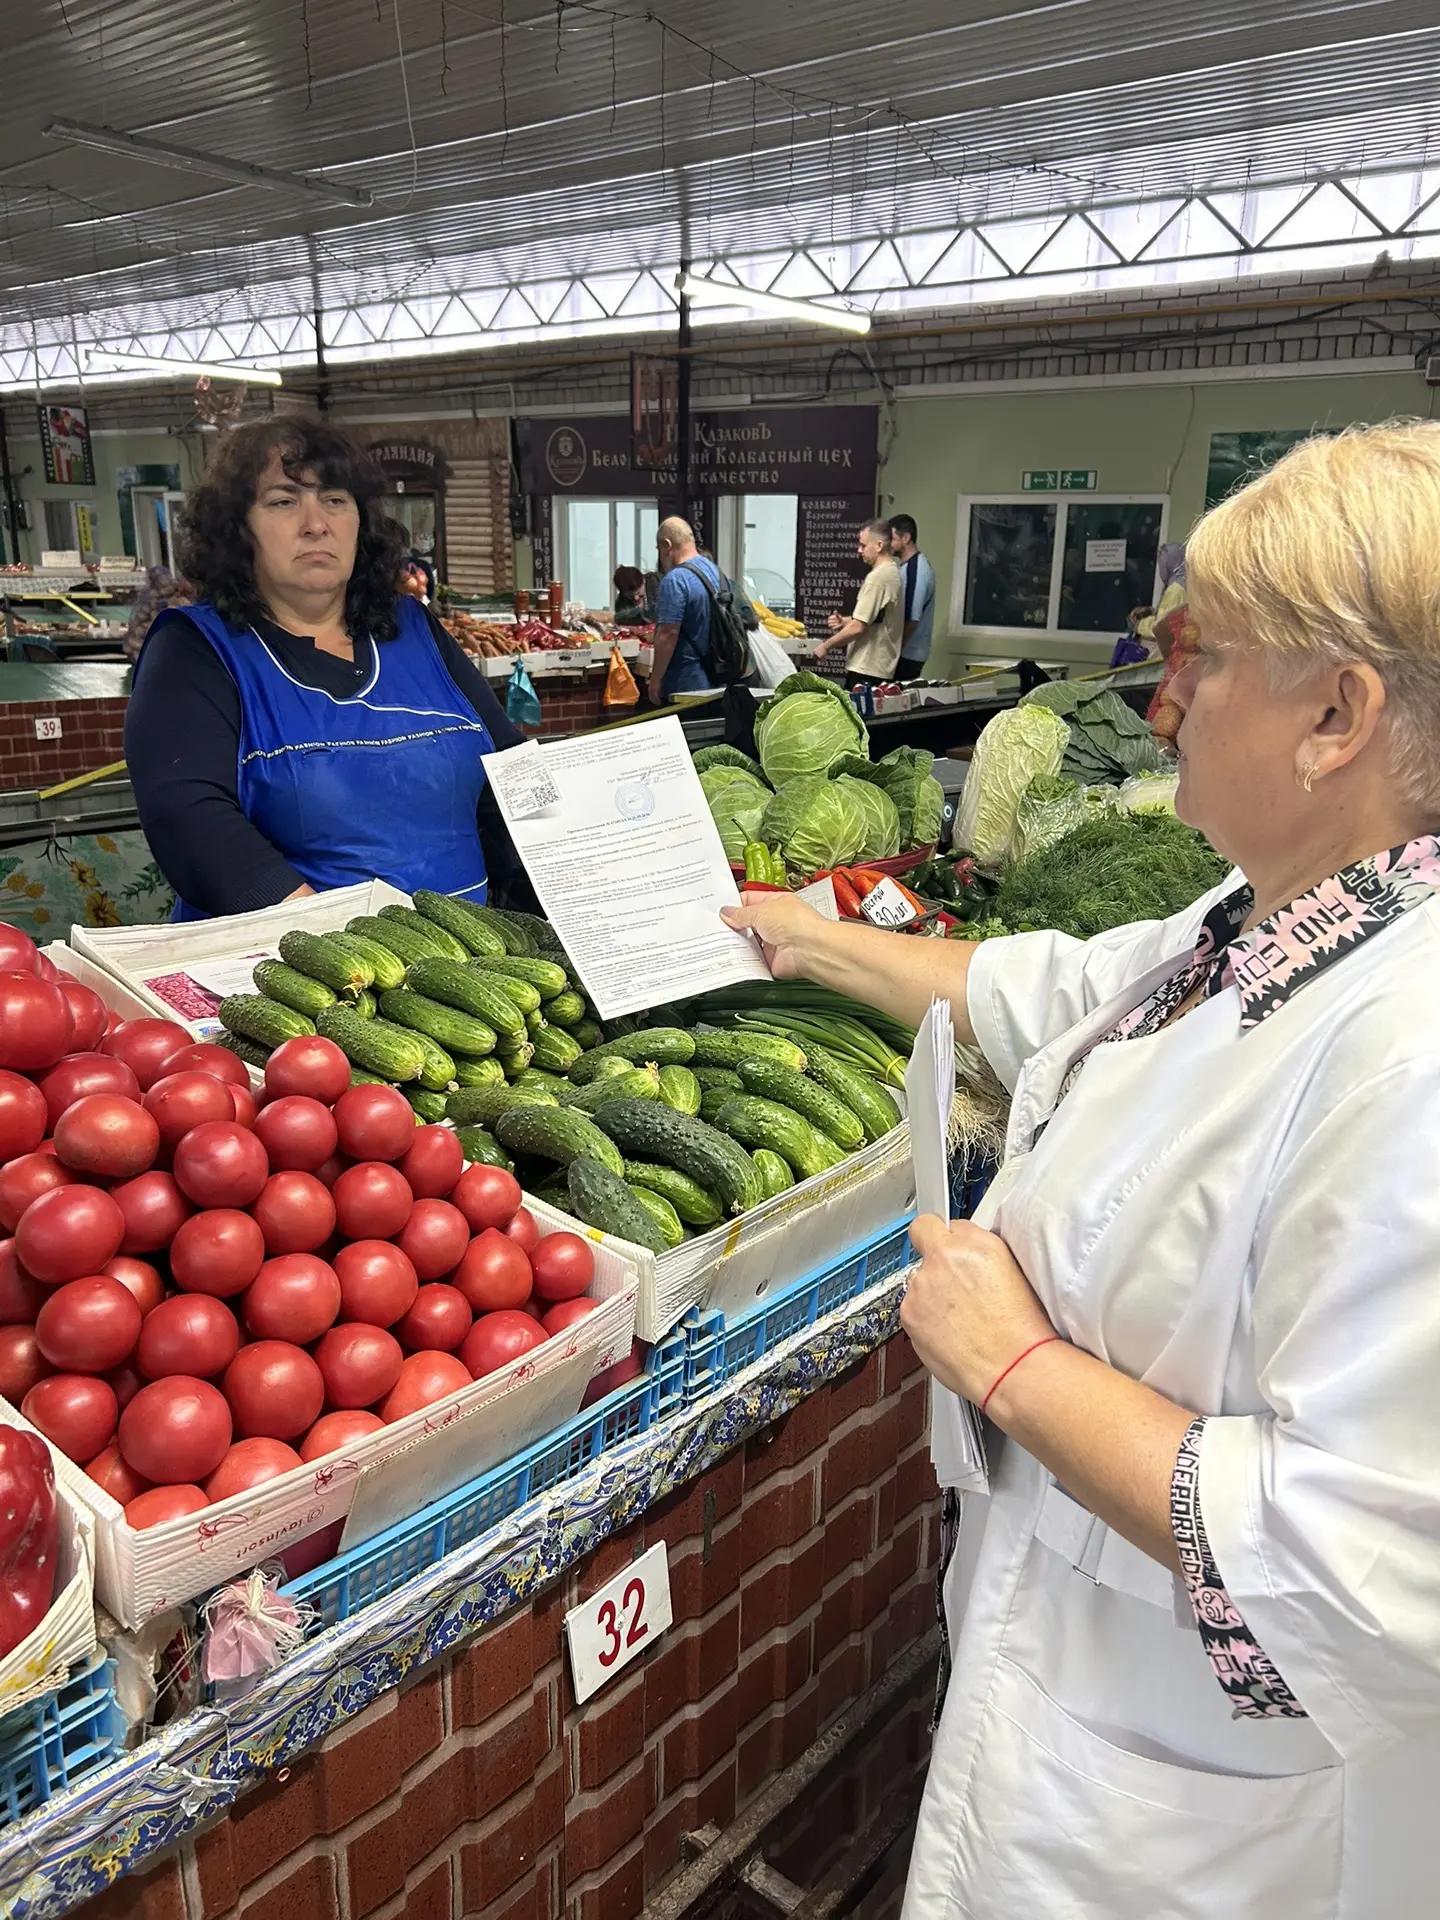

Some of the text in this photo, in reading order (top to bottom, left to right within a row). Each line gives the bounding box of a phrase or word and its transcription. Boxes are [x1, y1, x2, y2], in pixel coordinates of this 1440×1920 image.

[700, 470, 780, 484] качество
[42, 721, 56, 737] 39
[597, 1577, 649, 1667] 32
